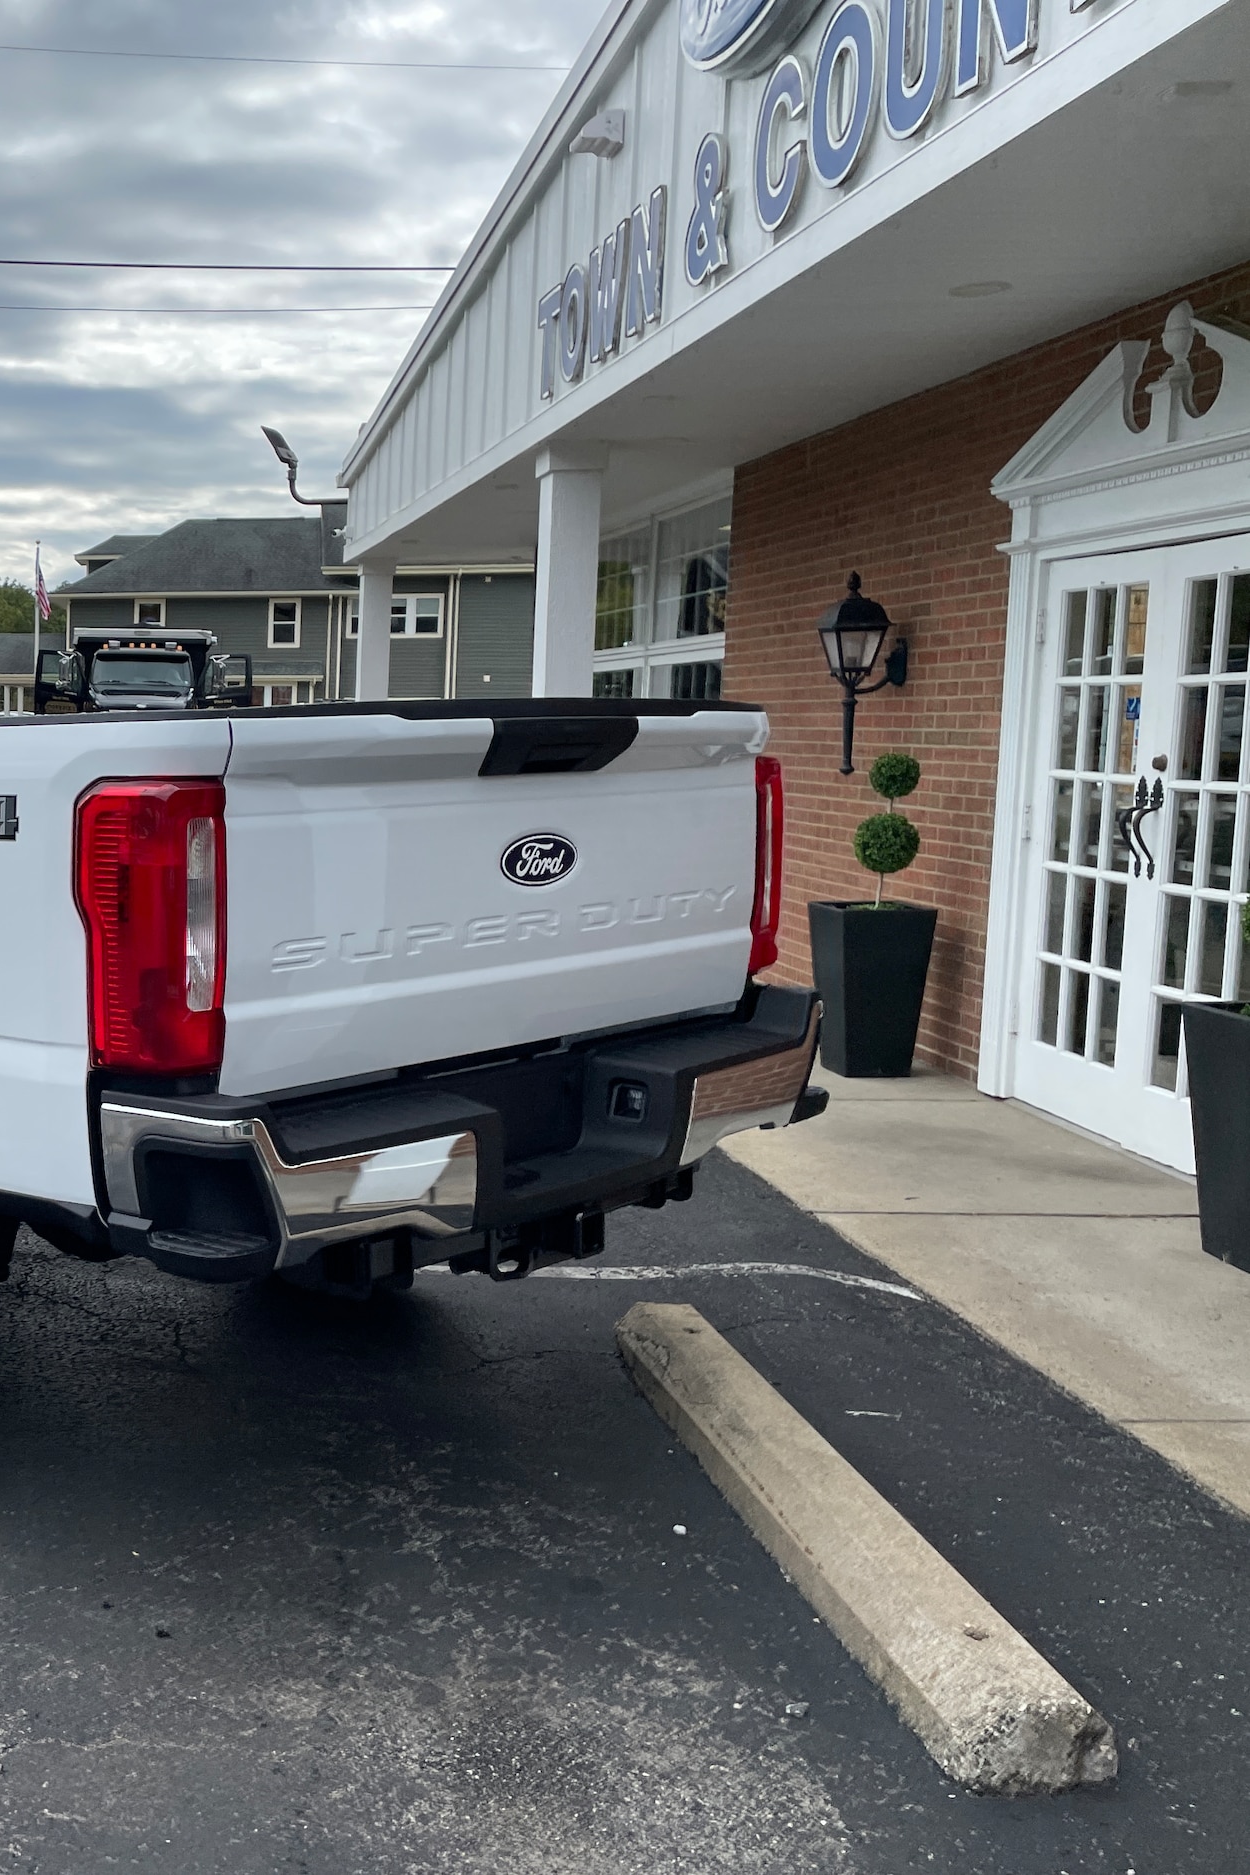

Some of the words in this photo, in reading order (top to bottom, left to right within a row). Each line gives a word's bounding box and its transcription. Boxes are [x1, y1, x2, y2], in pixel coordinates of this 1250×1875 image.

[537, 184, 668, 401] TOWN
[685, 131, 729, 288] &
[753, 0, 1092, 233] COUN
[515, 842, 564, 878] Ford
[270, 907, 561, 974] SUPER
[578, 884, 739, 933] DUTY
